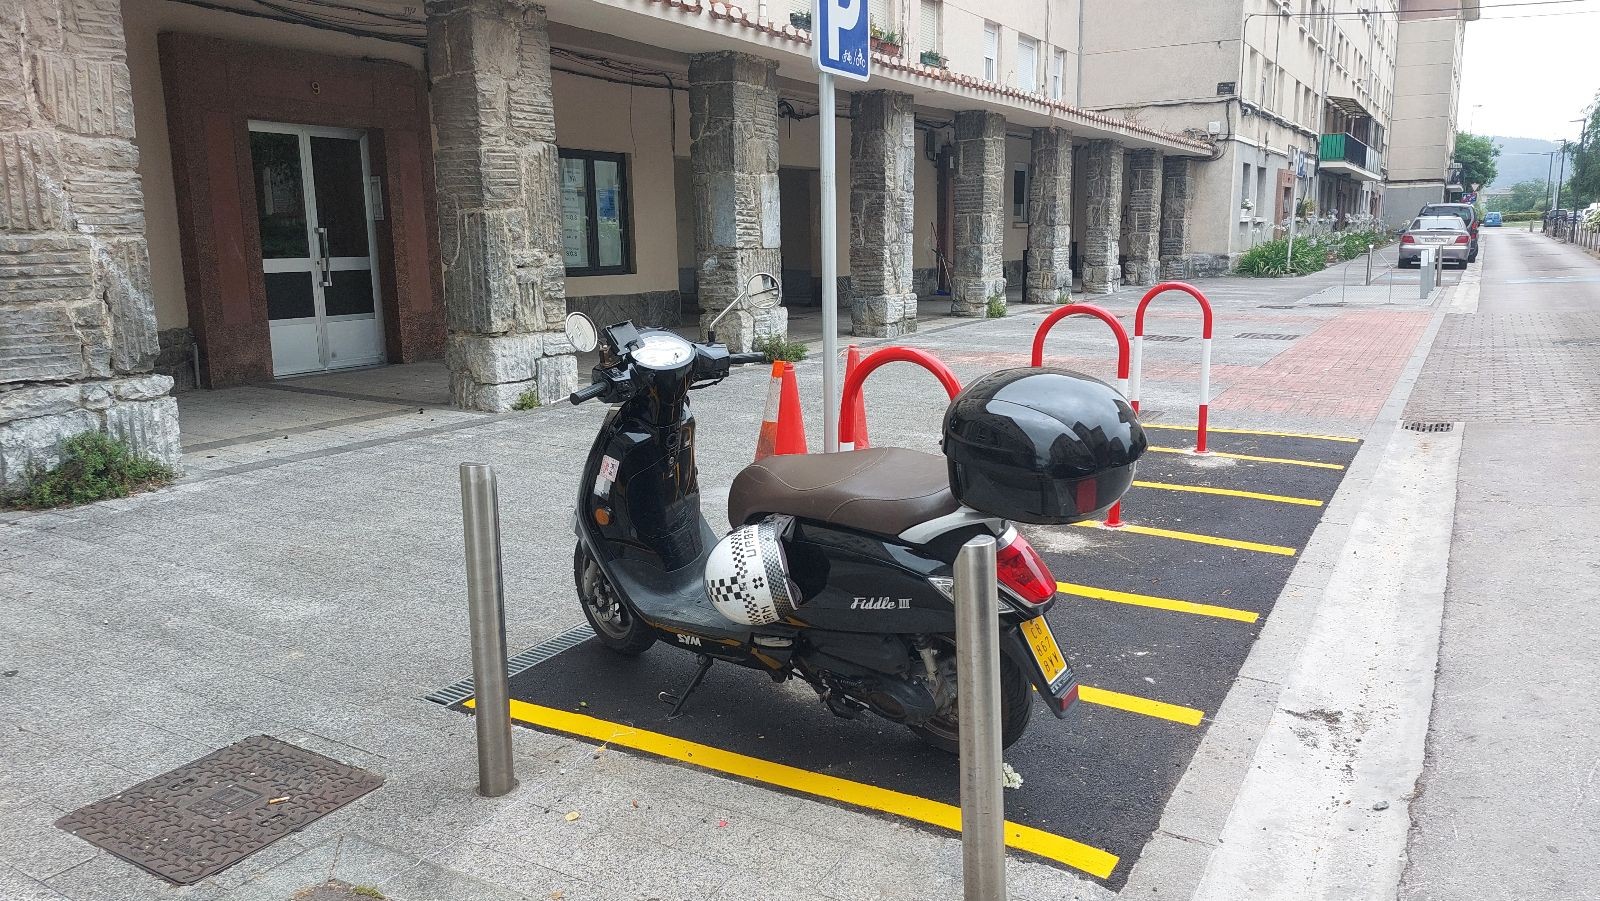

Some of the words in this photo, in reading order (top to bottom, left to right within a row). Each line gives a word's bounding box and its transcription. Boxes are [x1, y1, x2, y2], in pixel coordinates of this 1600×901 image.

[828, 0, 861, 62] P
[312, 81, 320, 95] 9
[850, 596, 897, 610] Fiddle
[677, 633, 702, 647] SYM
